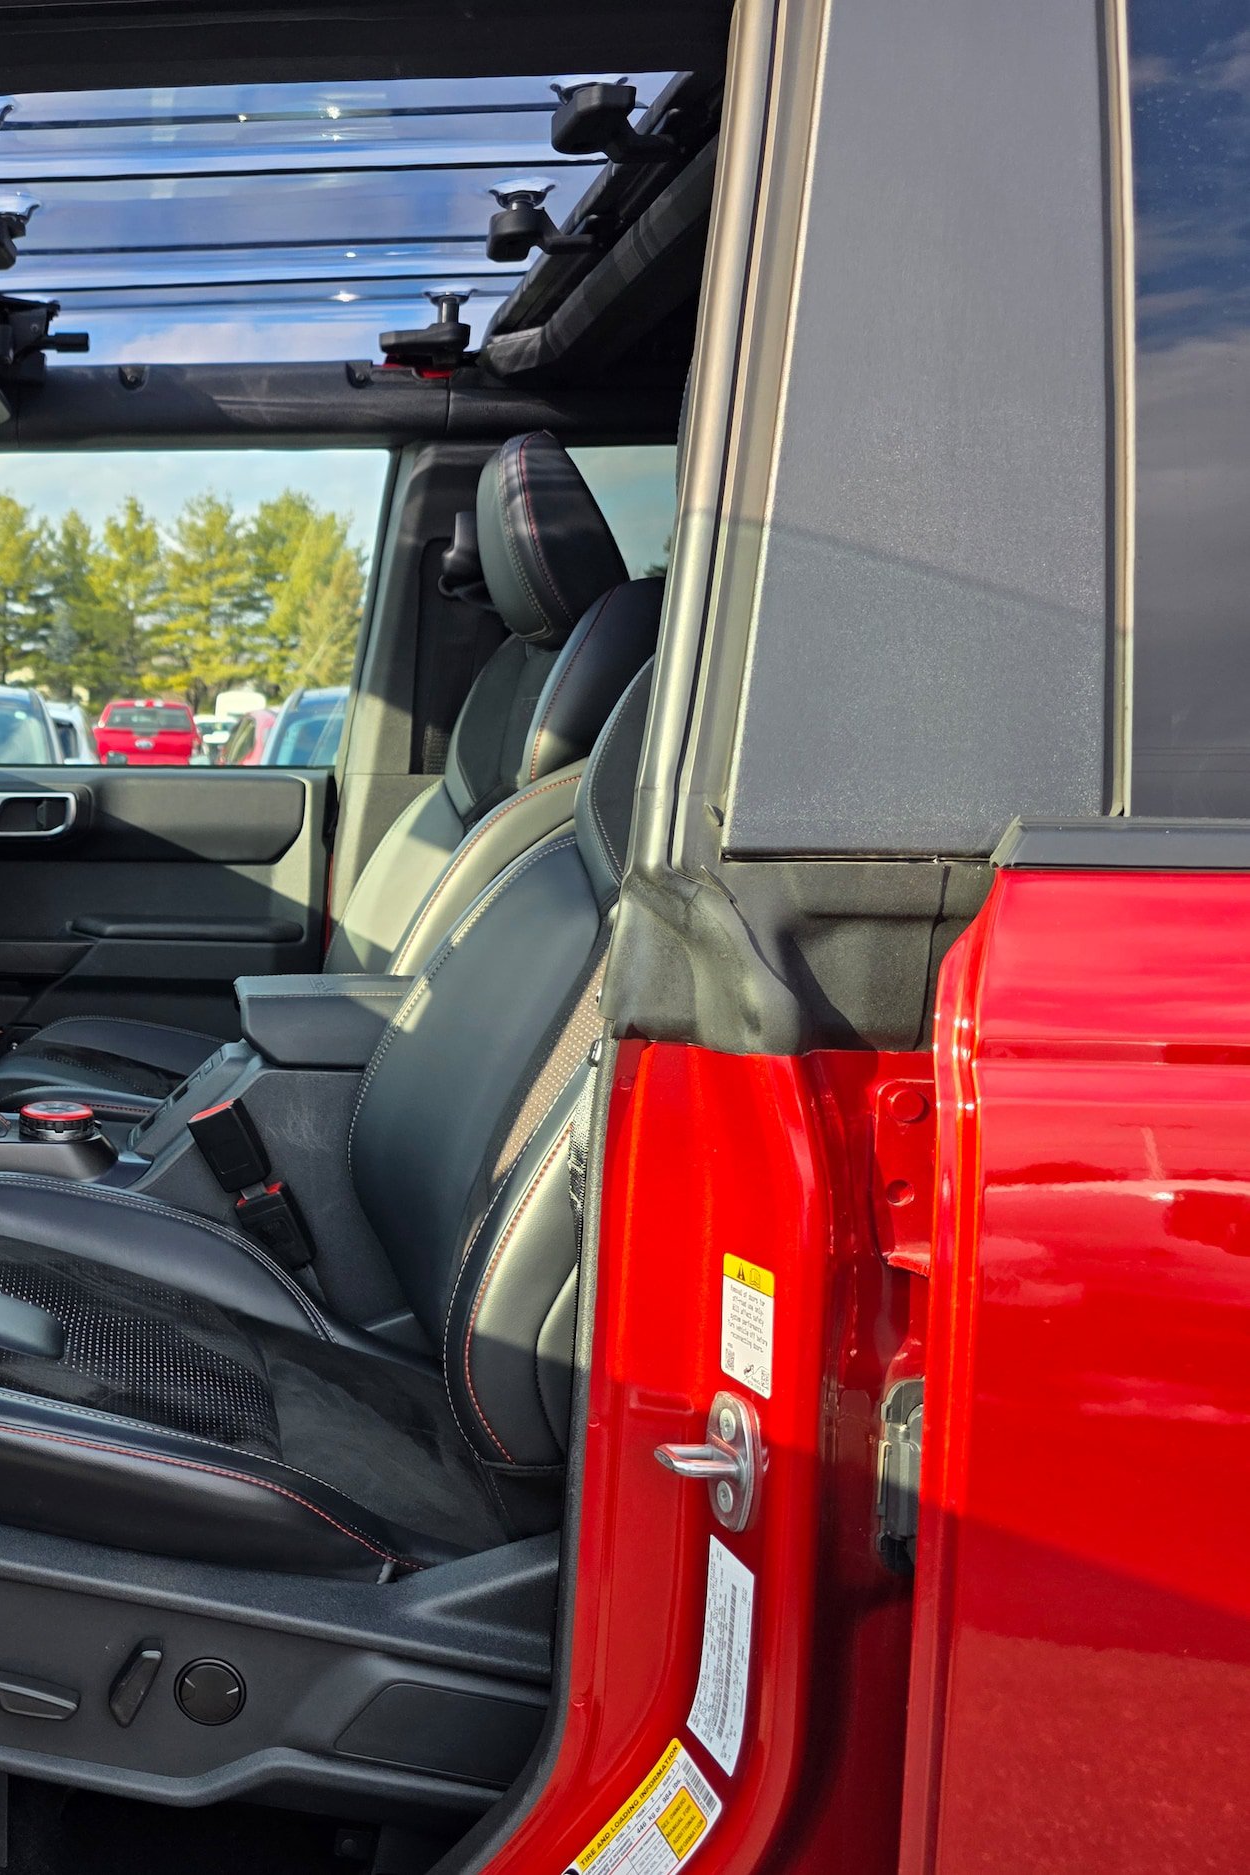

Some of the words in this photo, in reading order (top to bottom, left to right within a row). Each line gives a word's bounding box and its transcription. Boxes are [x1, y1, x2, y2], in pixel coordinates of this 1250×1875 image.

[580, 1847, 597, 1867] TIRE
[596, 1832, 611, 1849] AND
[610, 1799, 640, 1833] LOADING
[639, 1744, 679, 1799] INFORMATION
